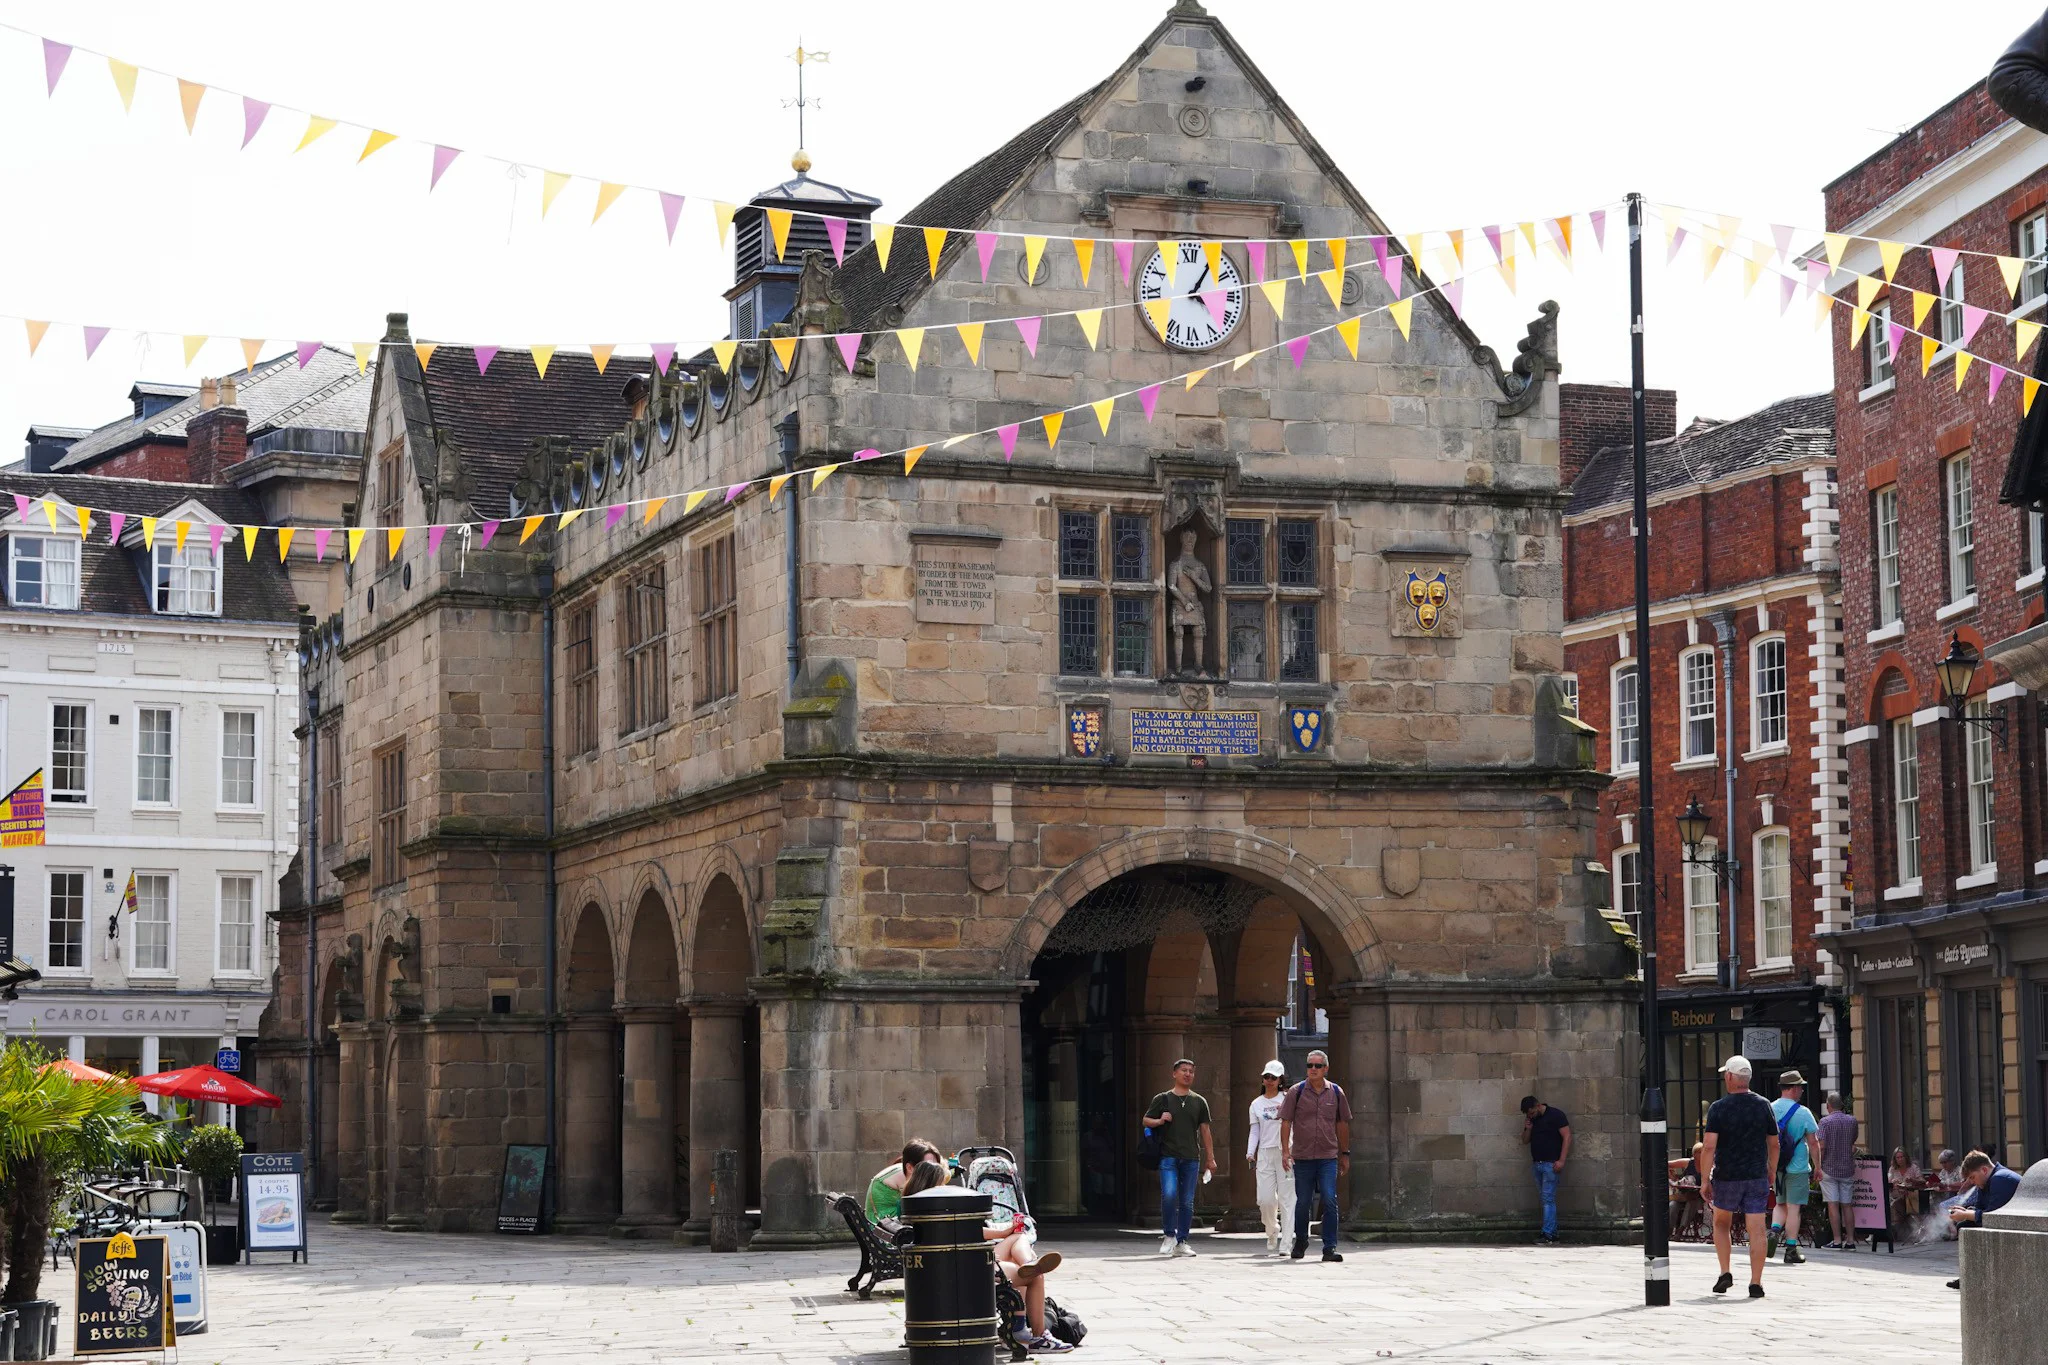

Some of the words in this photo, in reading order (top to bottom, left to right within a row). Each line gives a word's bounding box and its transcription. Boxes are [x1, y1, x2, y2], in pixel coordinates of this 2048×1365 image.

[1181, 249, 1198, 263] XII
[917, 560, 932, 568] THIS
[933, 561, 957, 569] STATUE
[958, 562, 972, 570] WAS
[926, 570, 948, 578] ORDER
[948, 571, 957, 579] OF
[972, 572, 995, 581] MAYOR
[924, 580, 943, 588] FROM
[944, 580, 958, 588] THE
[960, 581, 987, 589] TOWER
[929, 589, 943, 597] THE
[945, 590, 969, 598] WELSH
[969, 591, 993, 599] BRIDGE
[926, 598, 934, 606] IN
[935, 599, 950, 607] THE
[1133, 710, 1149, 718] THE
[1133, 719, 1172, 727] BVYLDING
[1235, 721, 1258, 729] IONES
[1133, 727, 1150, 735] AND
[1150, 728, 1184, 736] THOMAS
[1188, 729, 1231, 737] CHARLTON
[1133, 744, 1149, 752] AND
[1186, 745, 1196, 753] IN
[1223, 746, 1245, 754] TIME
[0, 821, 27, 831] SCENTED
[28, 820, 44, 829] SOAP
[3, 833, 34, 847] MAKER
[1861, 961, 1875, 972] Coffee
[1878, 957, 1892, 970] Brunch
[1895, 955, 1914, 968] Cocktails
[44, 1008, 109, 1021] CAROL
[122, 1009, 191, 1022] GRANT
[1671, 1009, 1716, 1027] Barbour
[253, 1155, 293, 1167] CÔTE
[259, 1185, 289, 1194] 14.95
[111, 1240, 132, 1255] Leffe
[83, 1260, 118, 1281] NOW
[86, 1269, 150, 1292] SERVING
[79, 1311, 128, 1323] DAILY
[90, 1325, 148, 1340] BEERS
